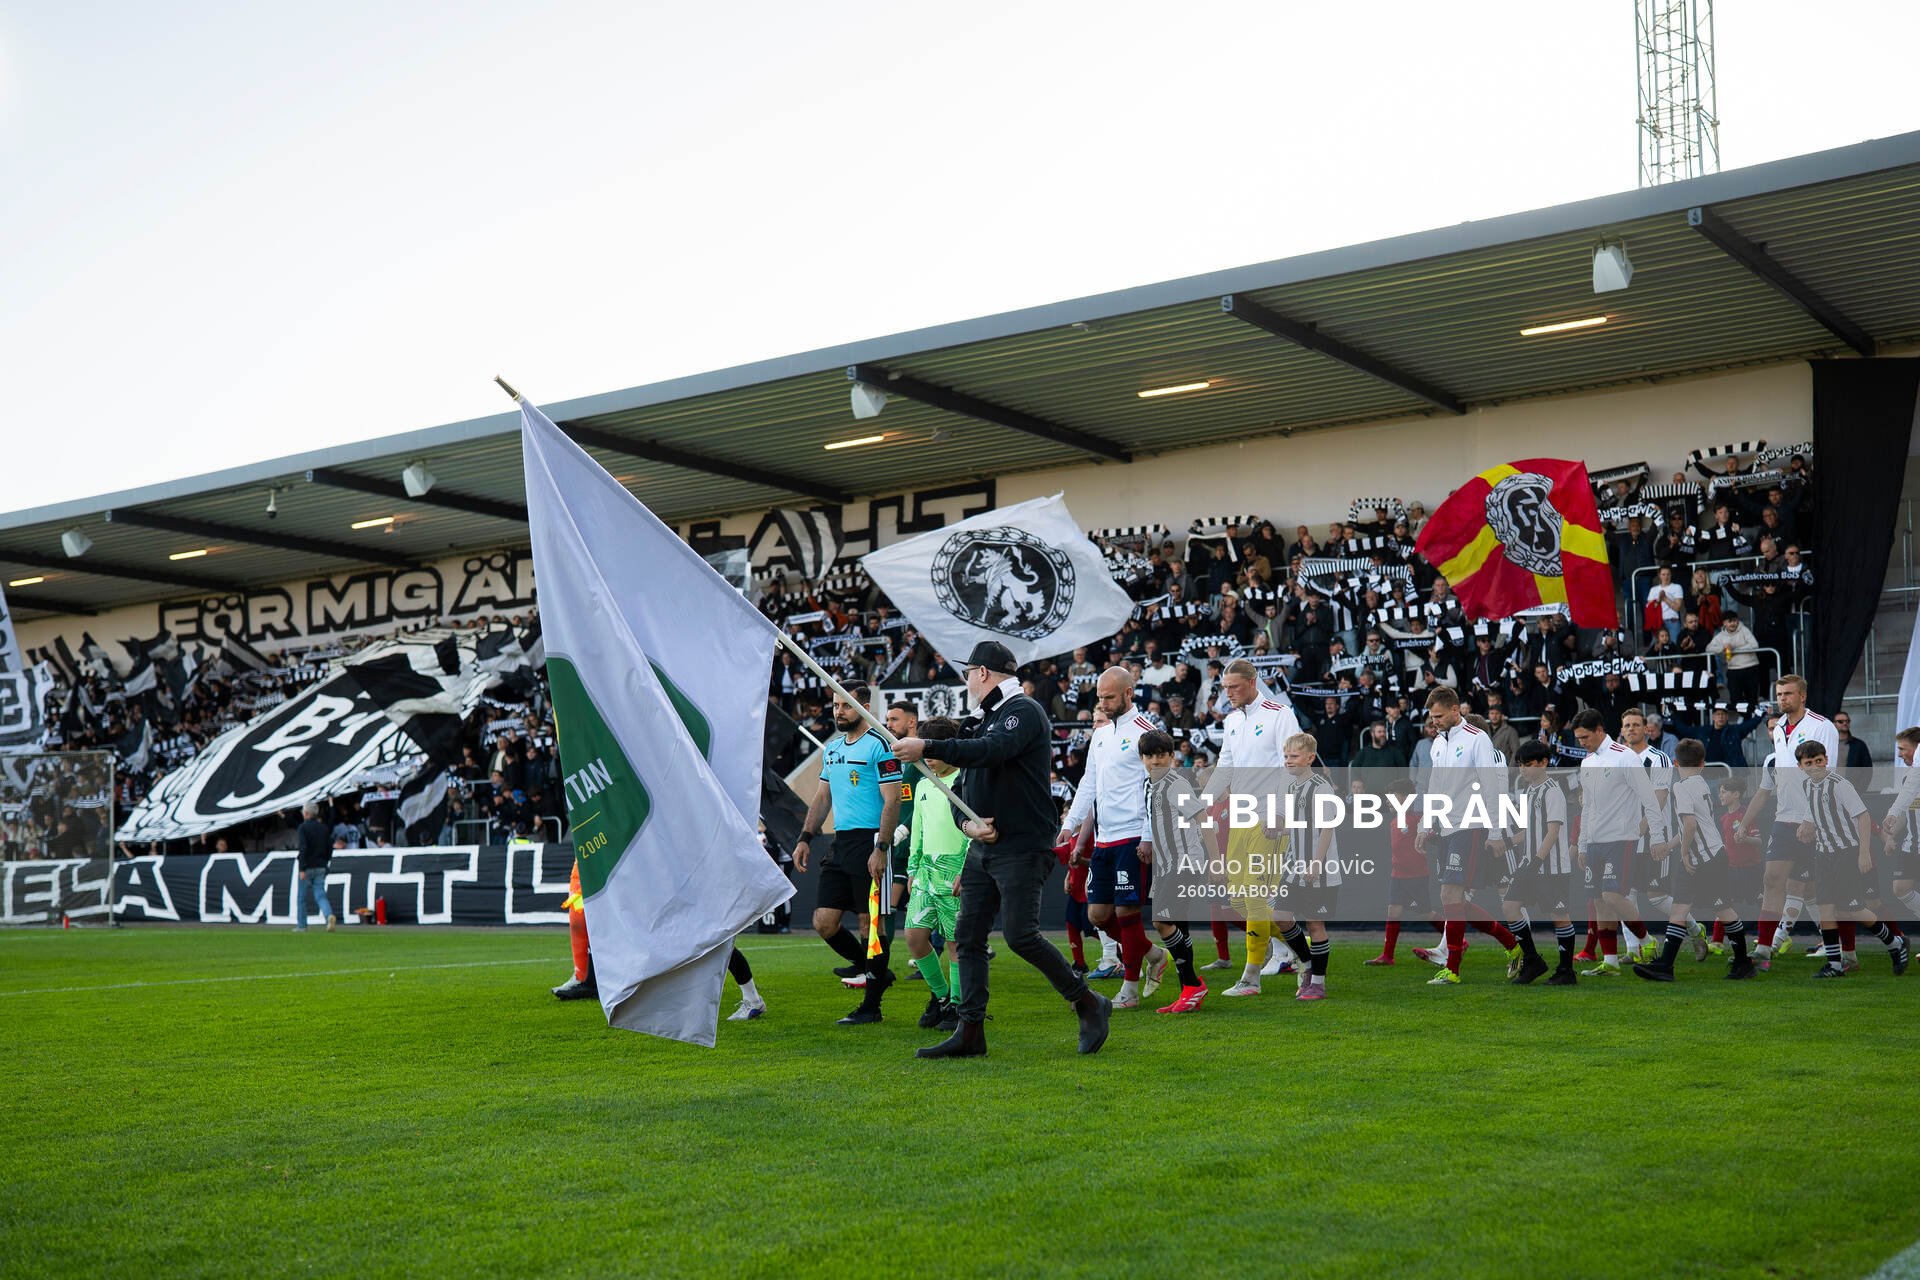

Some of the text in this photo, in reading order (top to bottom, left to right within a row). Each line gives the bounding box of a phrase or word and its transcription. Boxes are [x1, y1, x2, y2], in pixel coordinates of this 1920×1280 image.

[158, 587, 301, 646] FÖR
[308, 565, 443, 635] MIG
[200, 844, 480, 924] MTT
[578, 831, 608, 860] 2000
